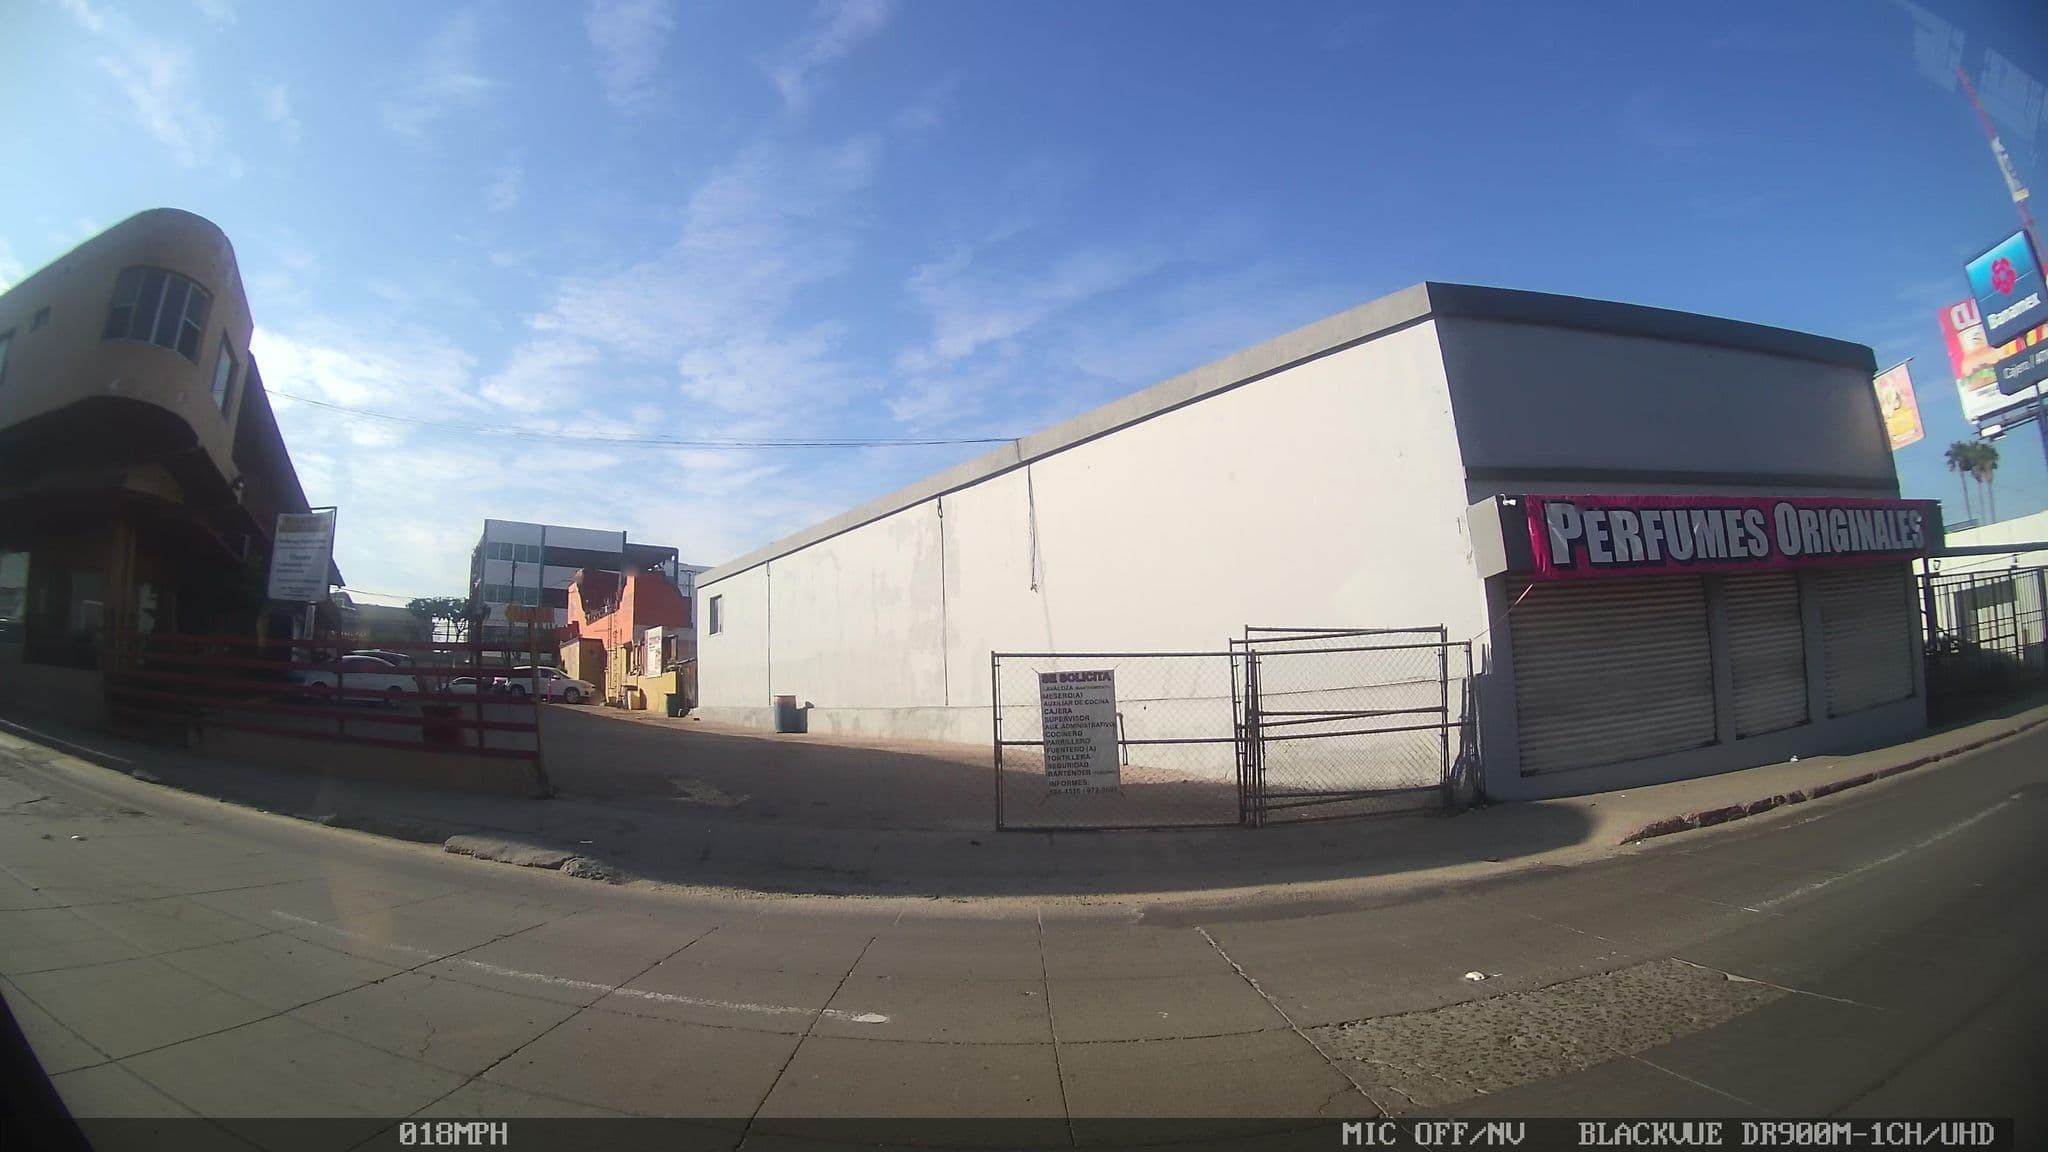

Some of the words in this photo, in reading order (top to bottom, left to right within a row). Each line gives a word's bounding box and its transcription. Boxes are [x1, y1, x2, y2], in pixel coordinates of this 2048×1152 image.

[1987, 292, 2041, 330] Banamex
[1543, 502, 1770, 565] PERFUMES
[1774, 501, 1926, 557] ORIGINALES
[1041, 673, 1057, 684] SE
[1059, 671, 1111, 683] SOLICITA
[1043, 707, 1073, 715] CAJERA
[1044, 715, 1090, 723] SUPERVISOR
[1045, 730, 1083, 738] COCINERO
[1046, 737, 1091, 745] PARRILLERO
[1048, 761, 1089, 769] SEGURIDAD
